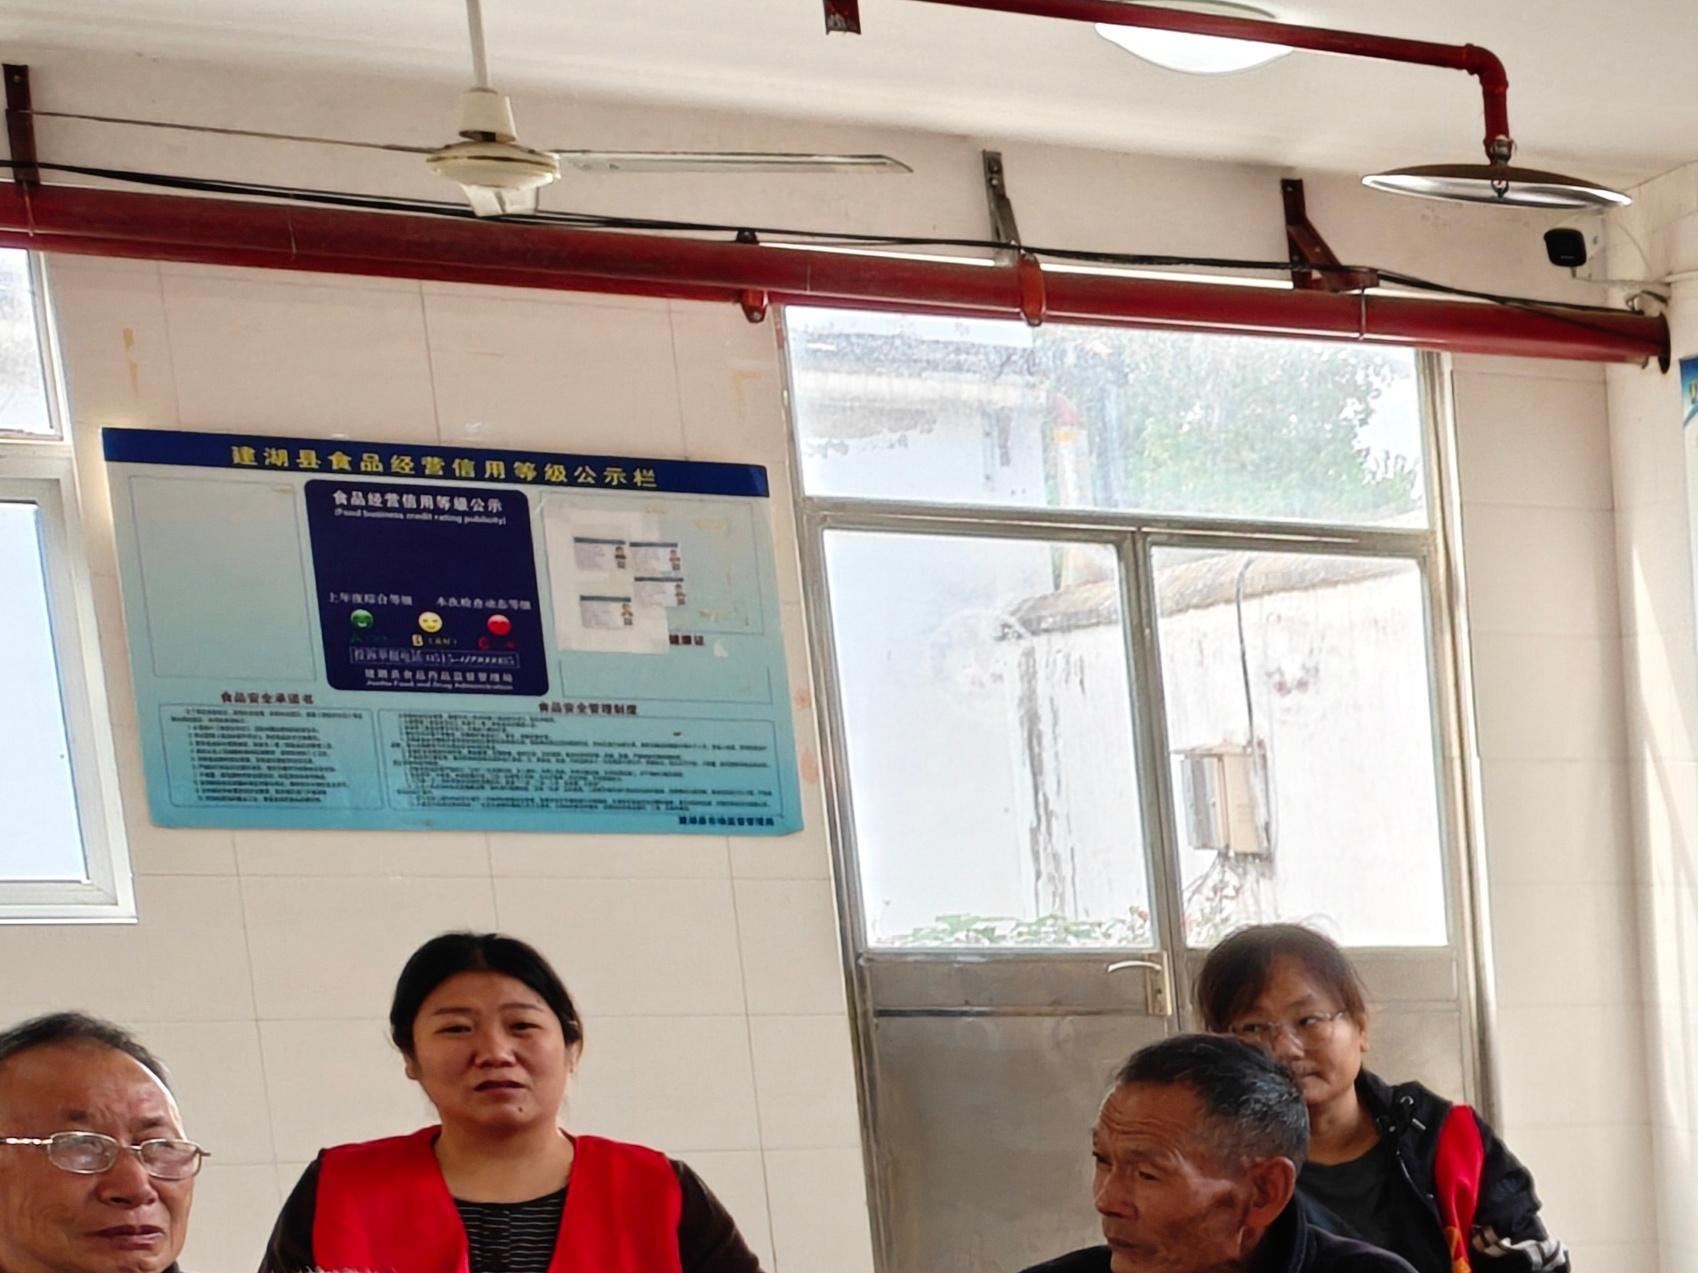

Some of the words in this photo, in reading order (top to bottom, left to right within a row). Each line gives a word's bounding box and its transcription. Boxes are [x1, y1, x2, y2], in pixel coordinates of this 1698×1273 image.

[231, 446, 657, 488] 建湖县食品经营信用等级公示栏
[333, 489, 502, 513] 食品经营信用等级公示
